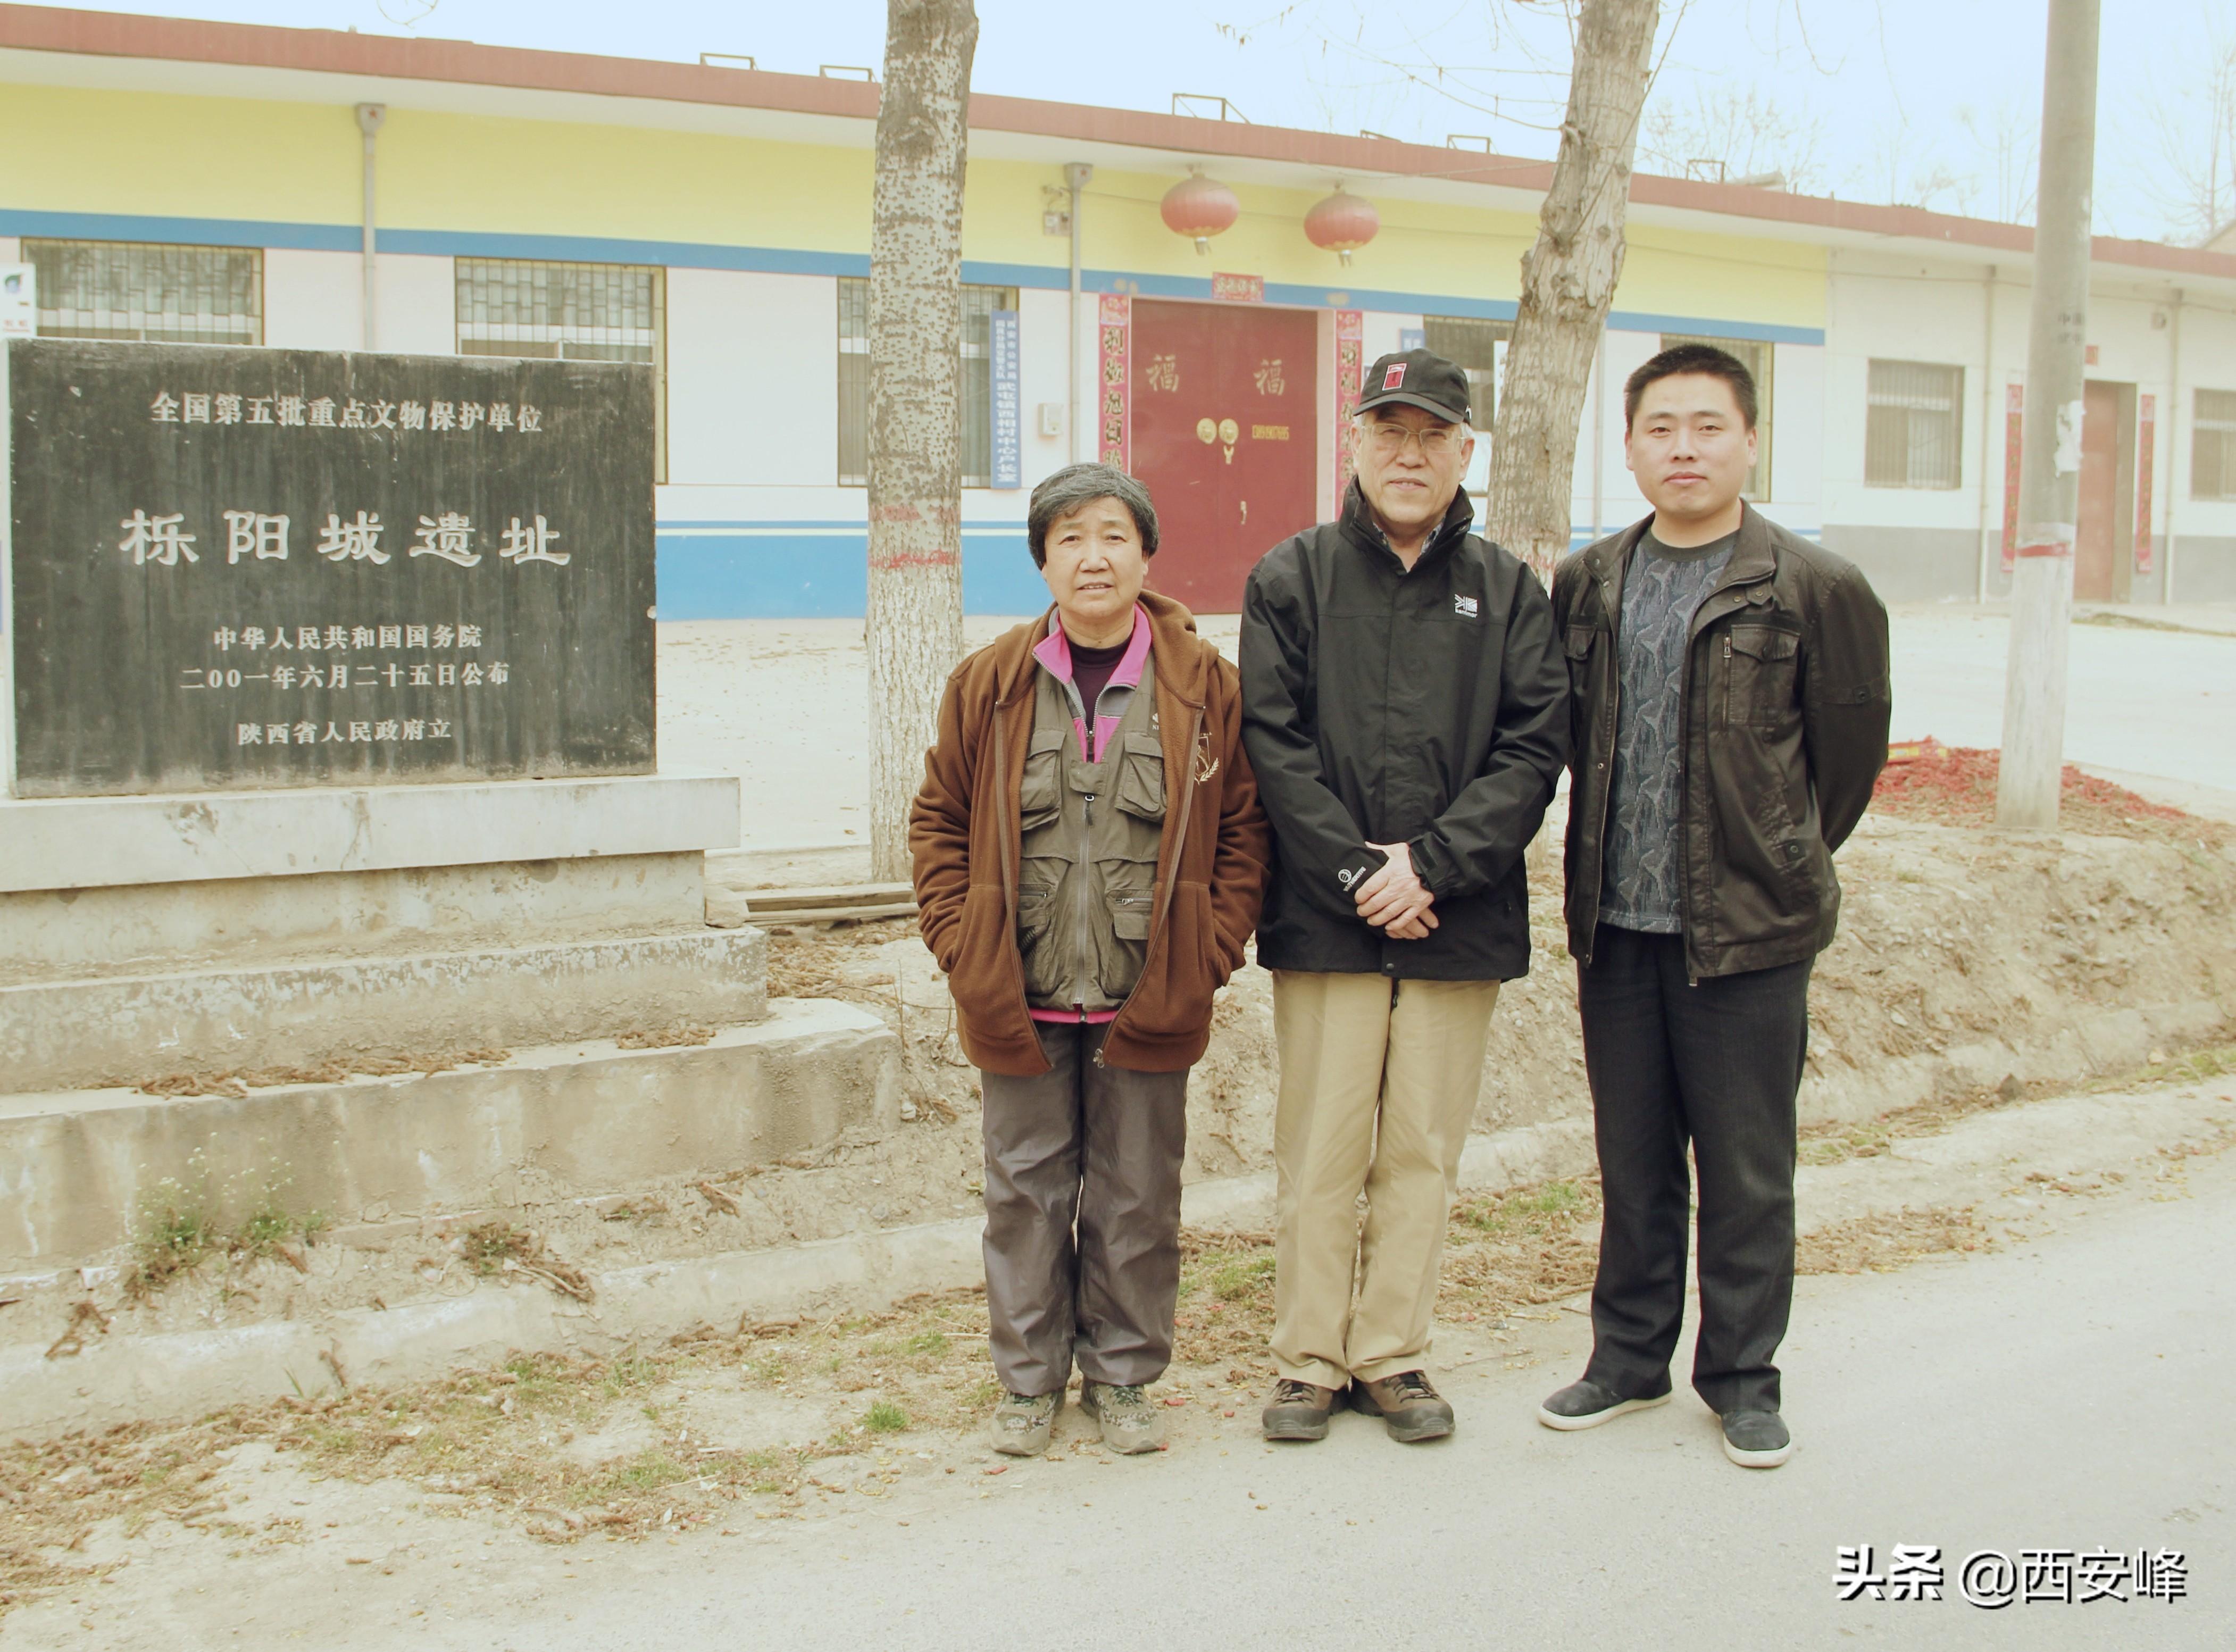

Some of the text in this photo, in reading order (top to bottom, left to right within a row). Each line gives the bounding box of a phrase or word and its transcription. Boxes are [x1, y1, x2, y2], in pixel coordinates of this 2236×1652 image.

[1146, 354, 1179, 392] 福
[1253, 359, 1284, 395] 福
[151, 391, 542, 432] 全国第五批重点文物保护单位
[119, 509, 571, 567] 栎阳城遗址
[214, 624, 482, 650] 中华人民共和国国务院
[238, 718, 451, 746] 陕西省人民政府立
